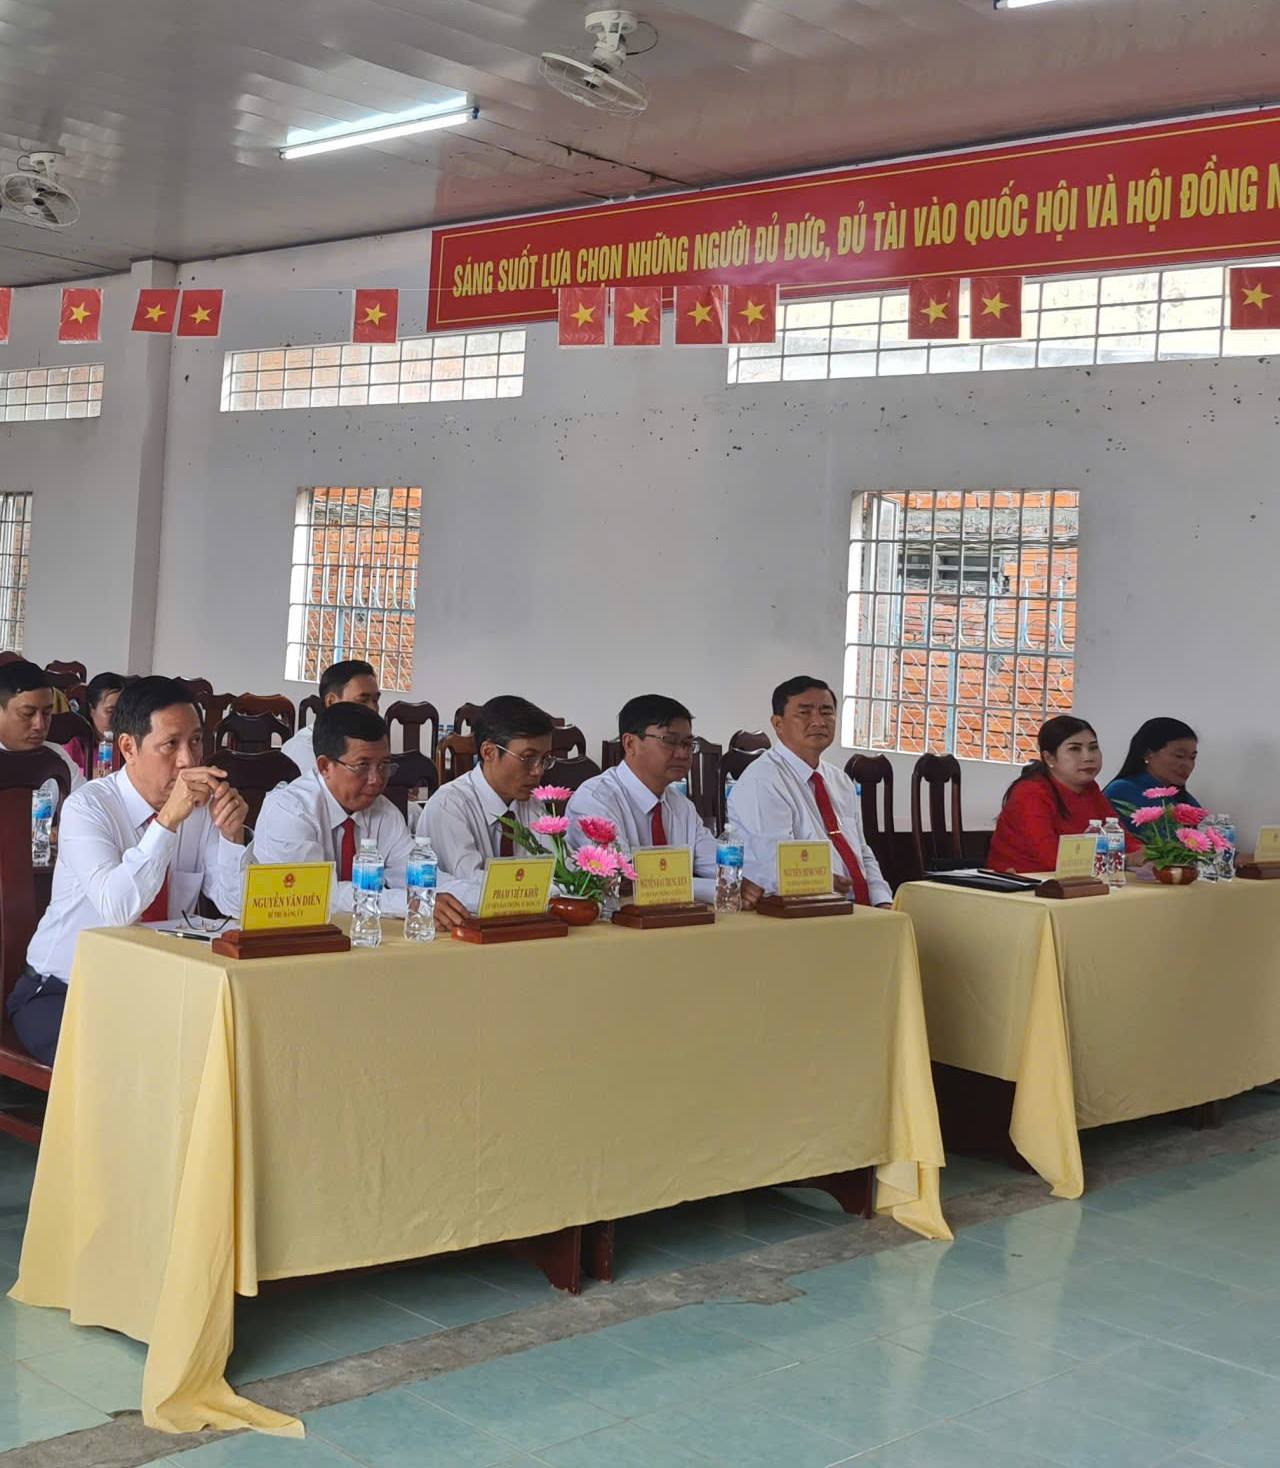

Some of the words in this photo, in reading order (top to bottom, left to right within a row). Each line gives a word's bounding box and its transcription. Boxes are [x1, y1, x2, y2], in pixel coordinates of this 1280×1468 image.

[453, 256, 494, 298] SÁNG
[498, 243, 538, 293] SUỐT
[542, 247, 572, 295] LỰA
[577, 243, 621, 288] CHỌN
[627, 232, 688, 276] NHỮNG
[693, 219, 750, 271] NGƯỜI
[754, 212, 780, 264] ĐỦ
[784, 212, 831, 262] ĐỨC,
[837, 201, 867, 256] ĐỦ
[873, 201, 908, 252] TÀI
[913, 197, 958, 247] VÀO
[964, 180, 1029, 246] QUỐC
[1035, 180, 1079, 241] HỘI
[1086, 174, 1119, 230] VÀ
[1126, 168, 1172, 232] HỘI
[1180, 154, 1259, 219] ĐỒNG
